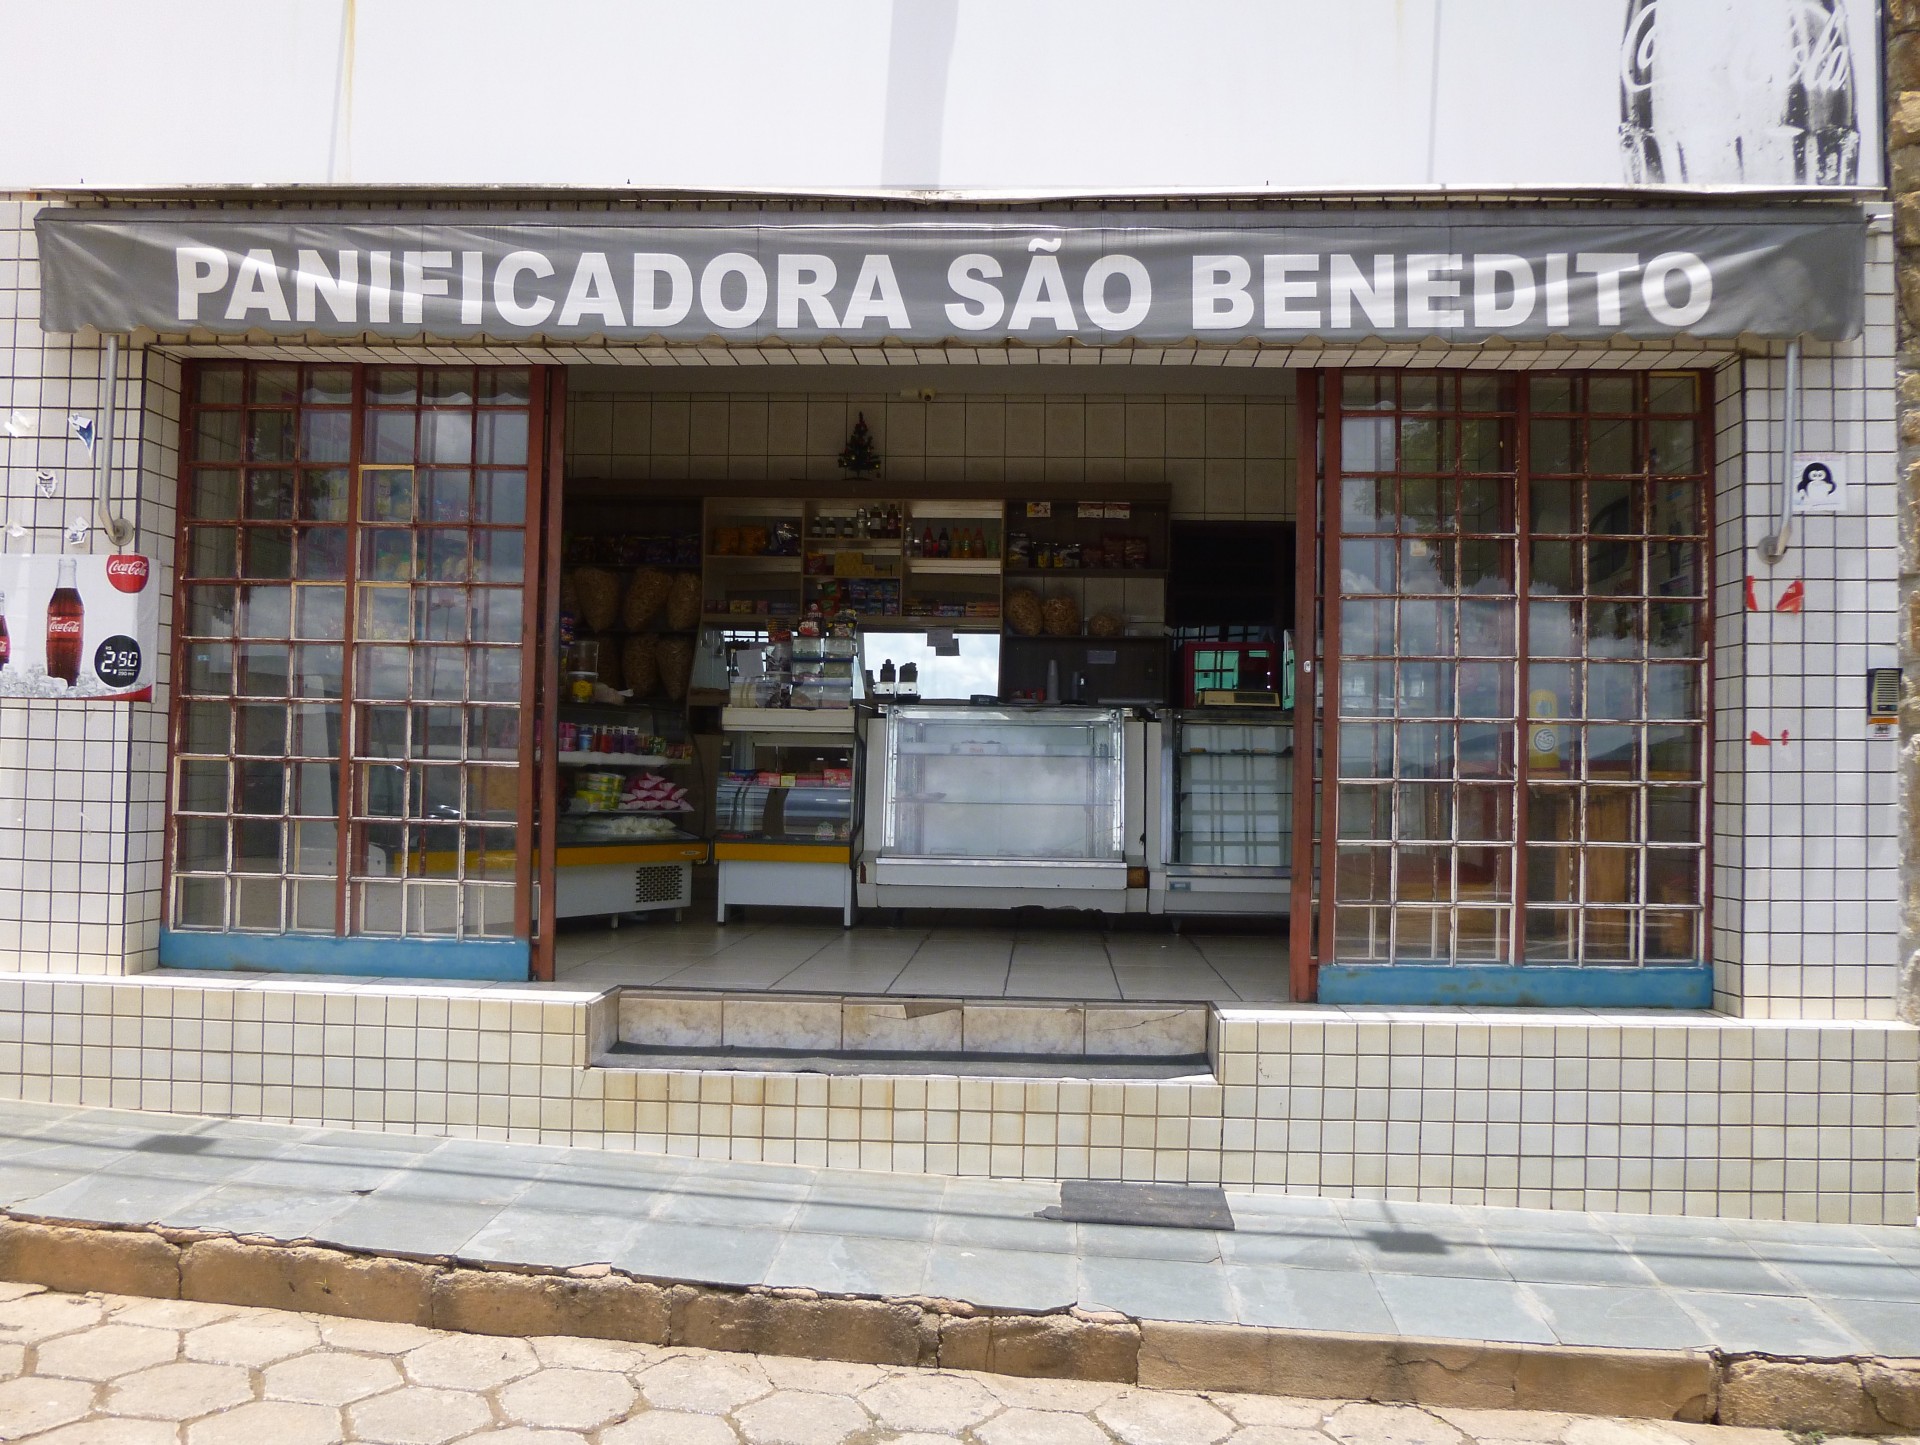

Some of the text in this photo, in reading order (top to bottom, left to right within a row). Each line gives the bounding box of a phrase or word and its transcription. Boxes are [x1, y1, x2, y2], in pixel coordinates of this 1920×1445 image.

[176, 237, 1714, 332] PANIFICADORA SÃO BENEDITO
